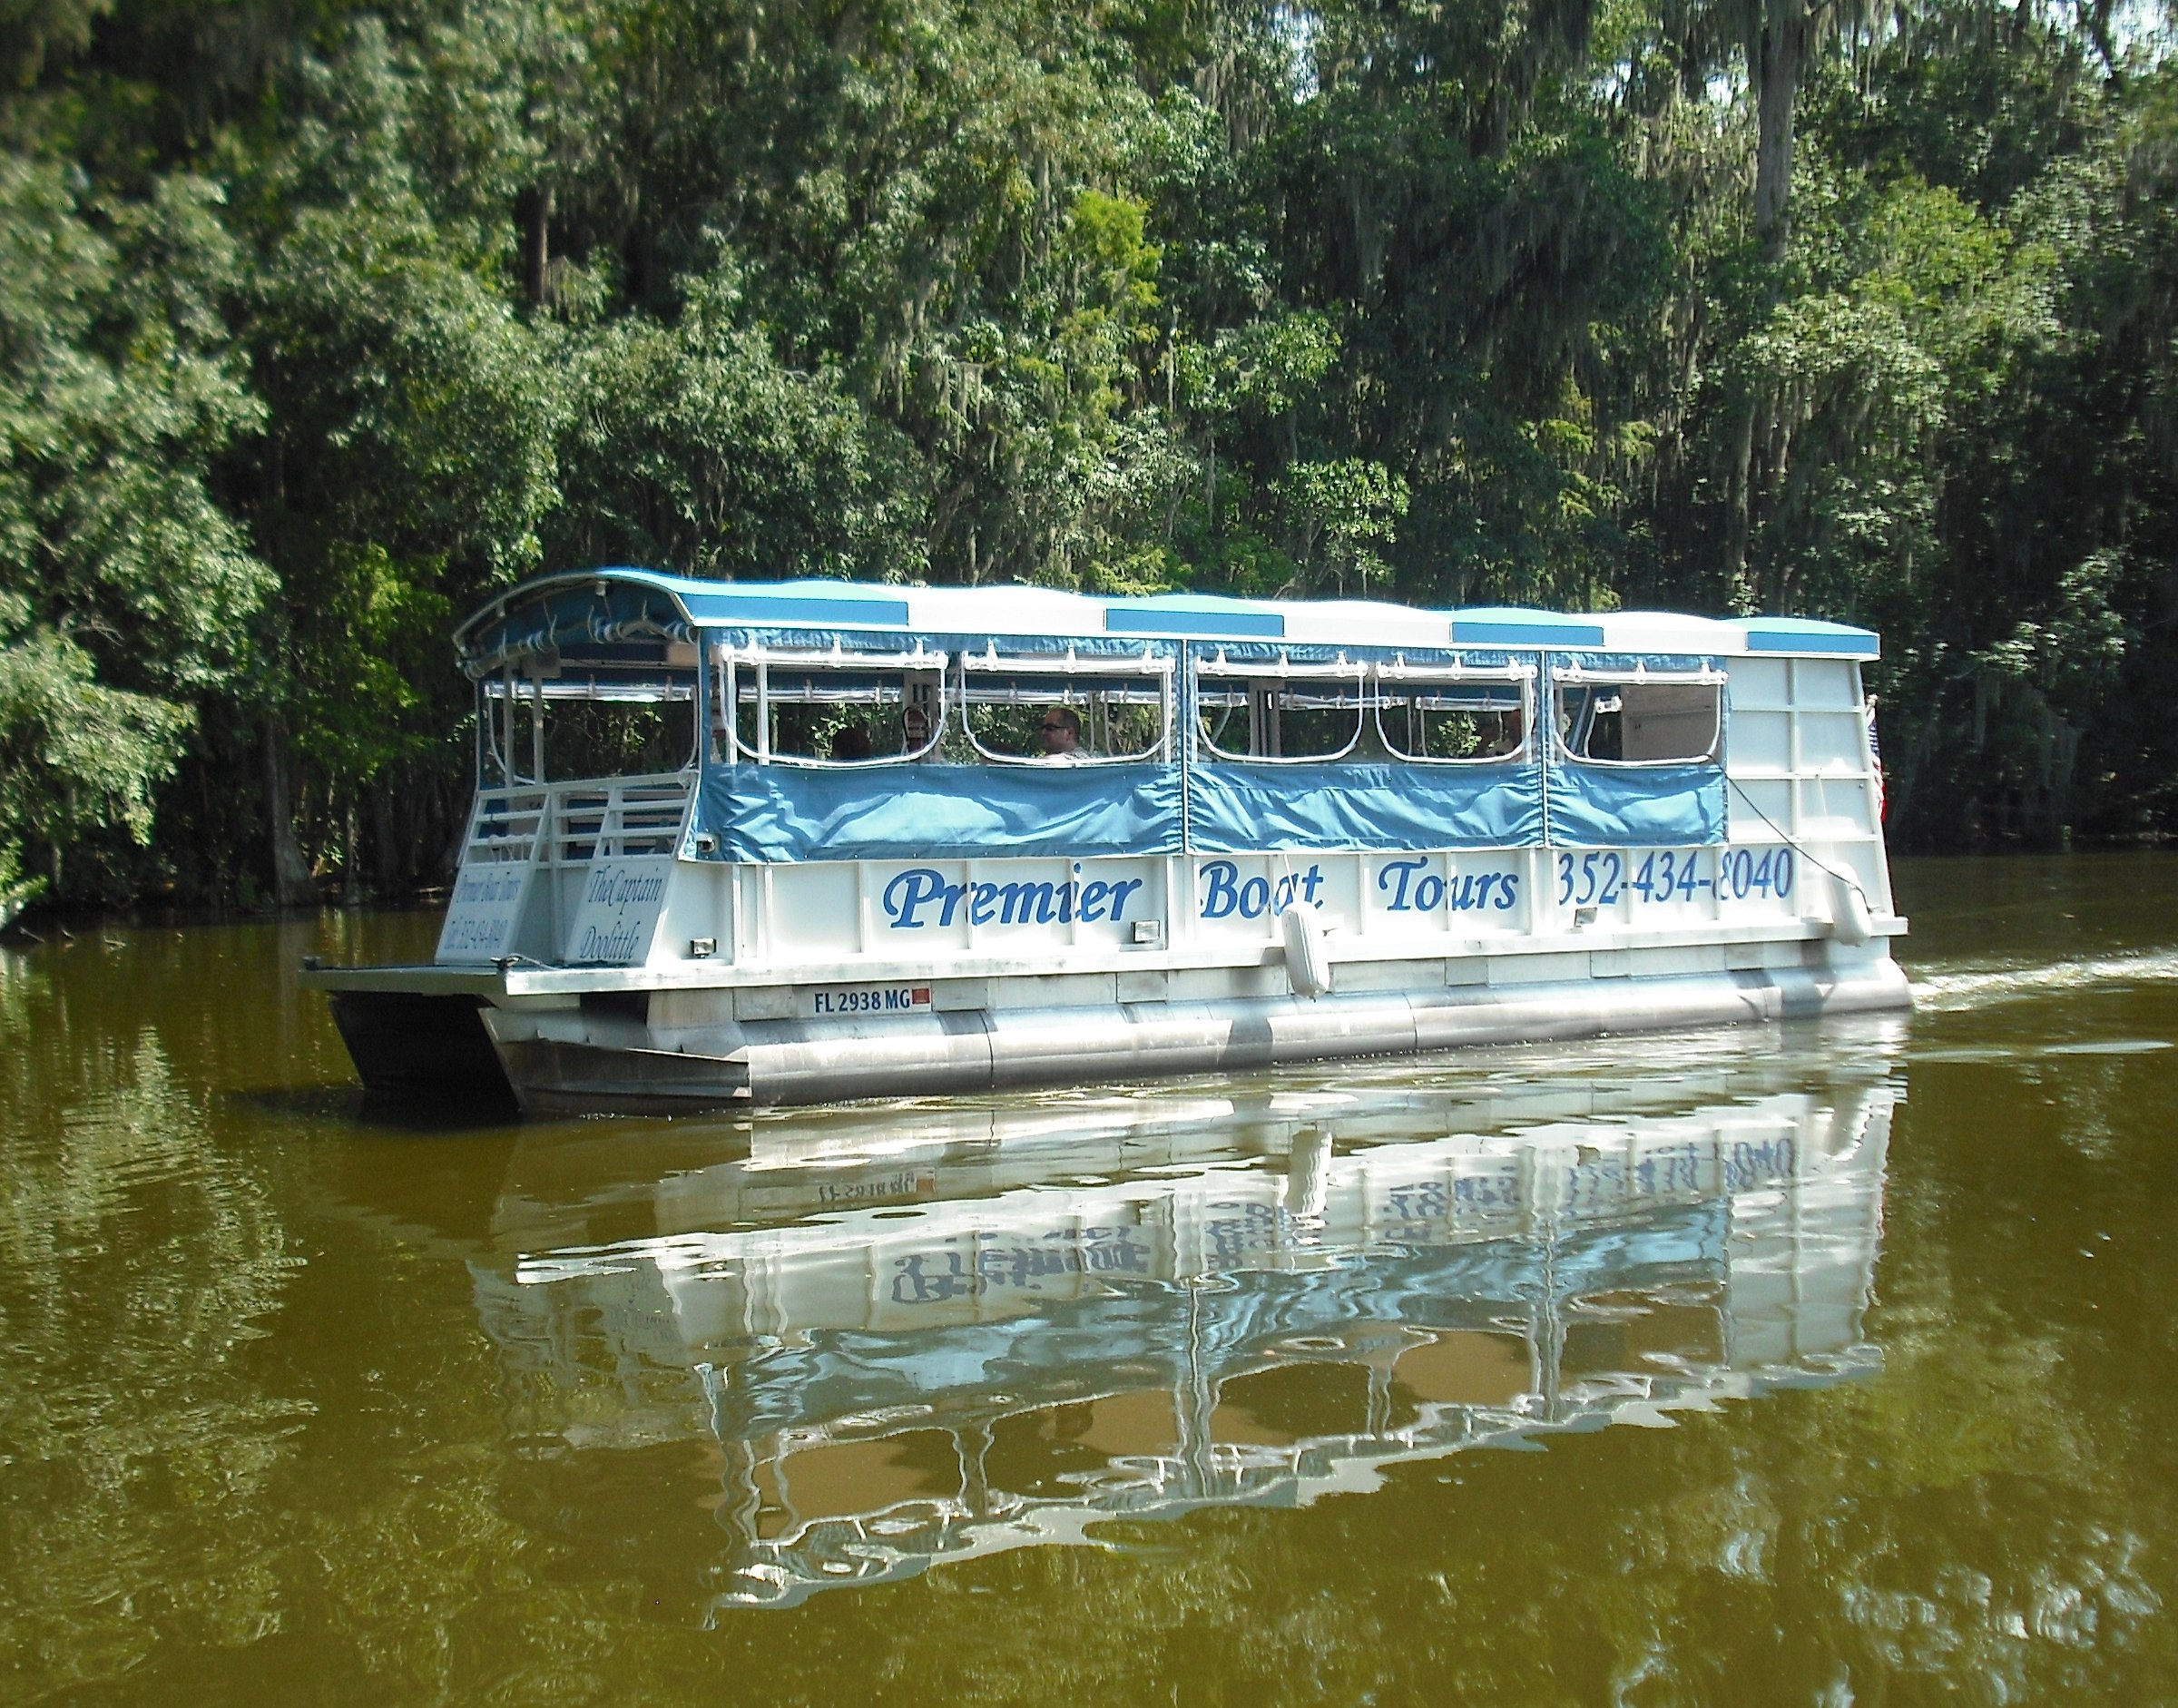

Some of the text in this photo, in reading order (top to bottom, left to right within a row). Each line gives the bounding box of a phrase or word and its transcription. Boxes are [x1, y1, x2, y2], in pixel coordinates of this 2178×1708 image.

[883, 856, 1519, 928] Premier Boat Tours
[815, 989, 910, 1013] FL 2938 MG
